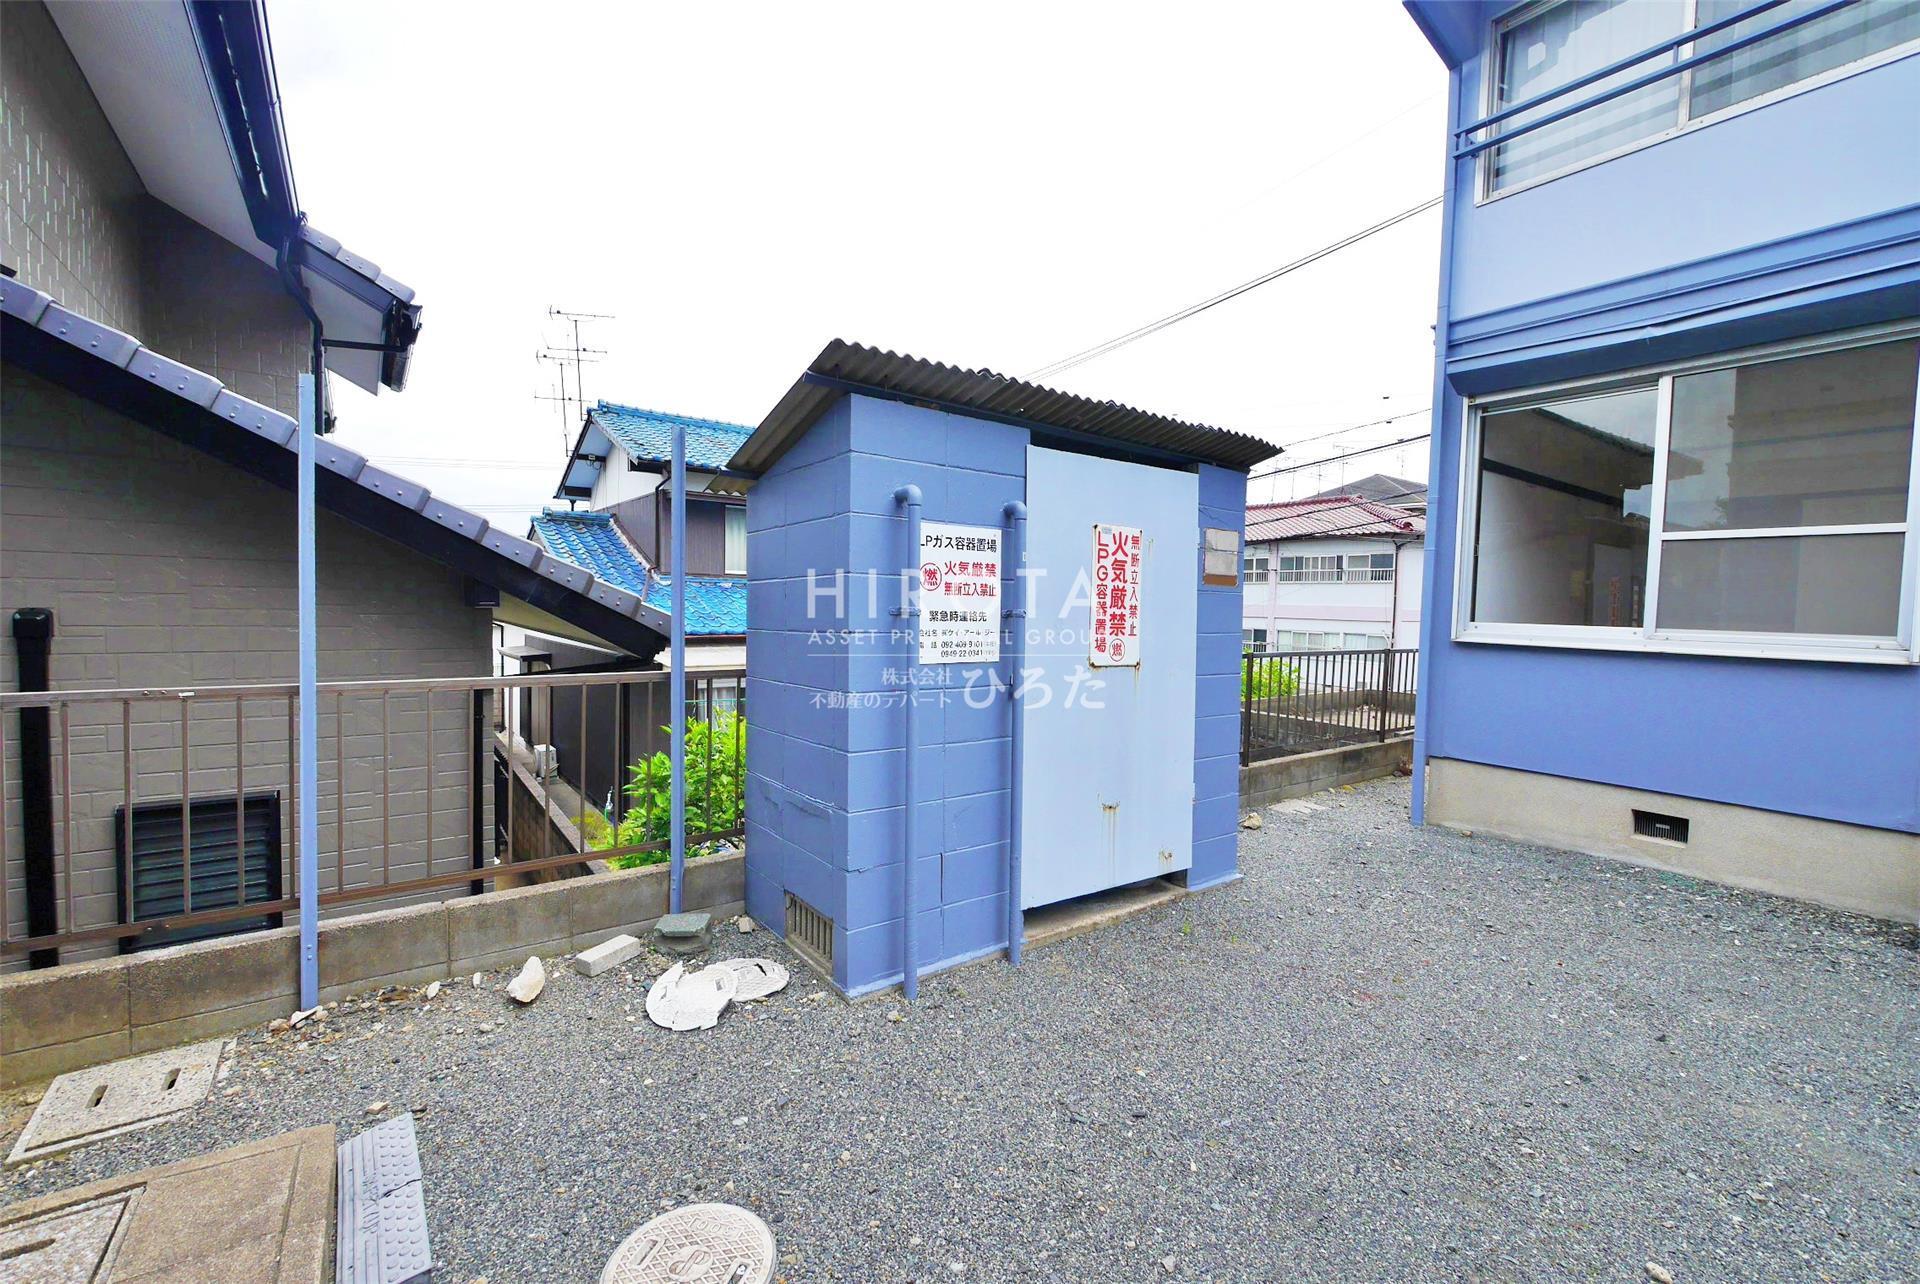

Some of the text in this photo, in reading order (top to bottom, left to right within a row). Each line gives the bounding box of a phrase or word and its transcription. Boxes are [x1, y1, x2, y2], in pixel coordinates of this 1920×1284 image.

[944, 561, 997, 577] 火気厳禁
[944, 581, 997, 597] 無断立入禁止
[1095, 531, 1109, 653] LPG容器置場
[1109, 531, 1128, 637] 火気厳禁
[1128, 535, 1140, 637] 無断立入禁止
[929, 610, 987, 623] 緊急時連絡先
